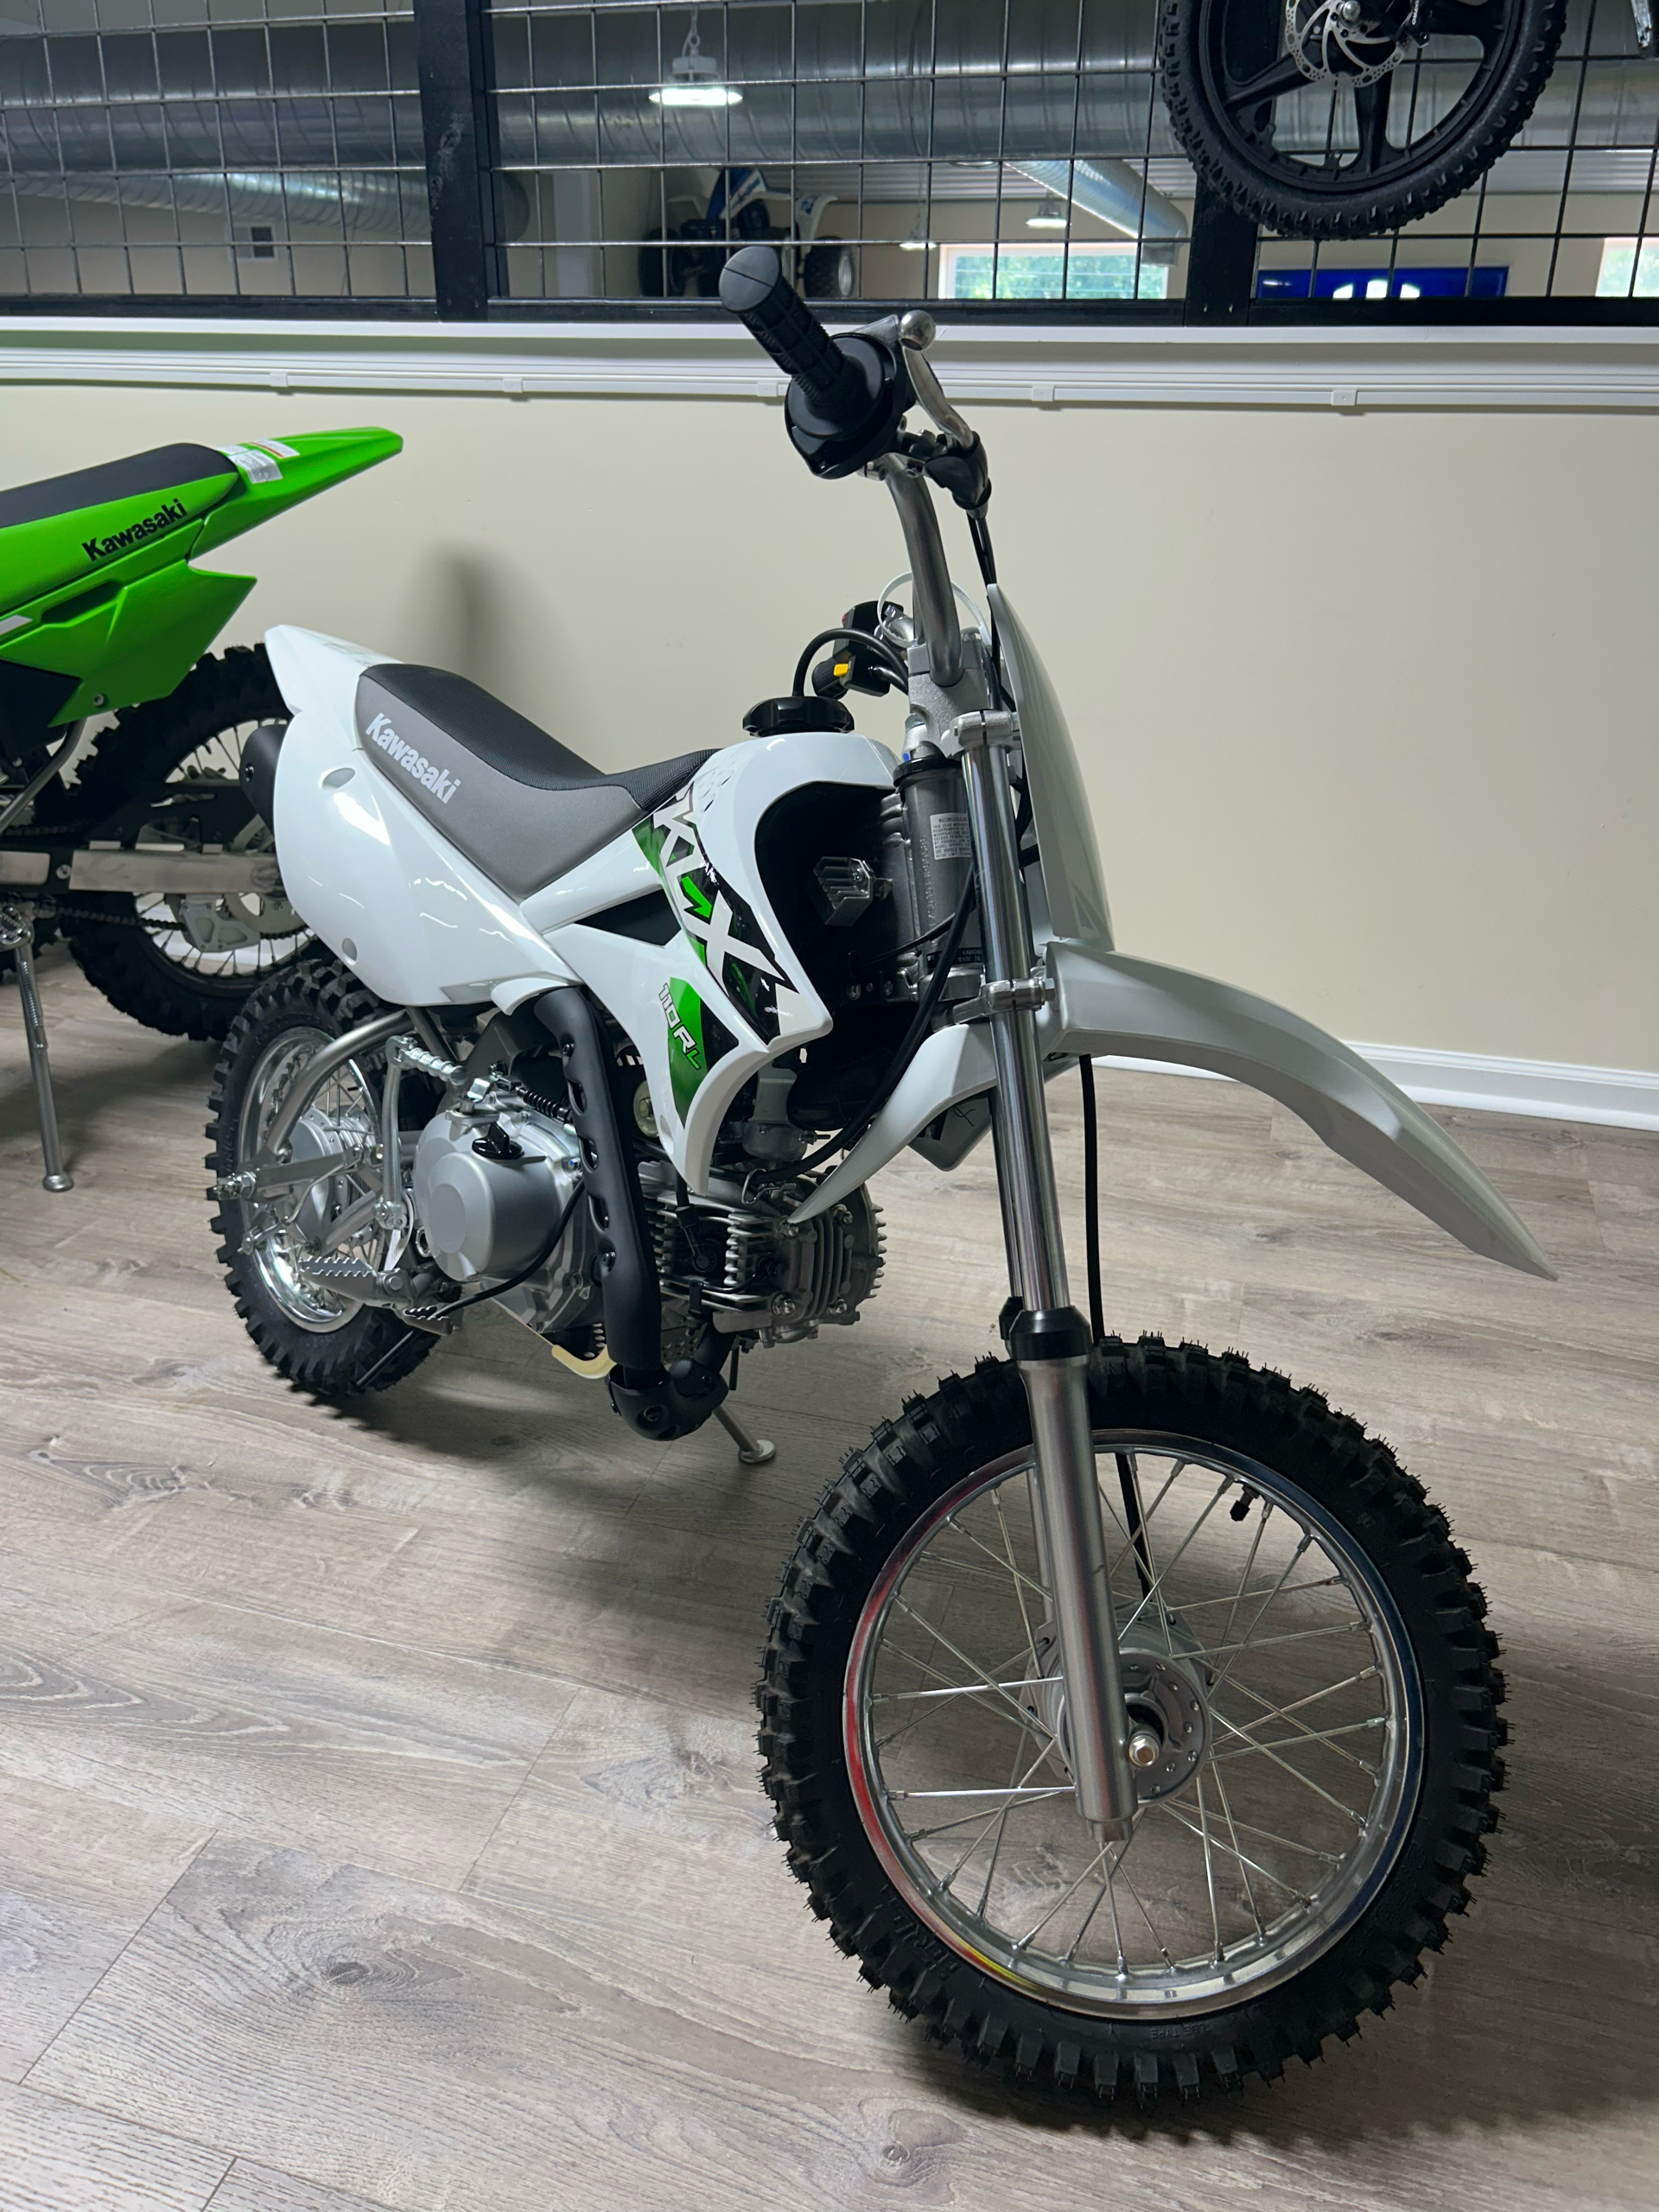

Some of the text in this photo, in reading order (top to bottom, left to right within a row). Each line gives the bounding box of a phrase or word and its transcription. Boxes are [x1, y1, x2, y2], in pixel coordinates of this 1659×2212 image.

[82, 498, 188, 561] Kawasaki
[365, 712, 461, 804] Kawasaki
[1150, 2027, 1180, 2040] TYPE
